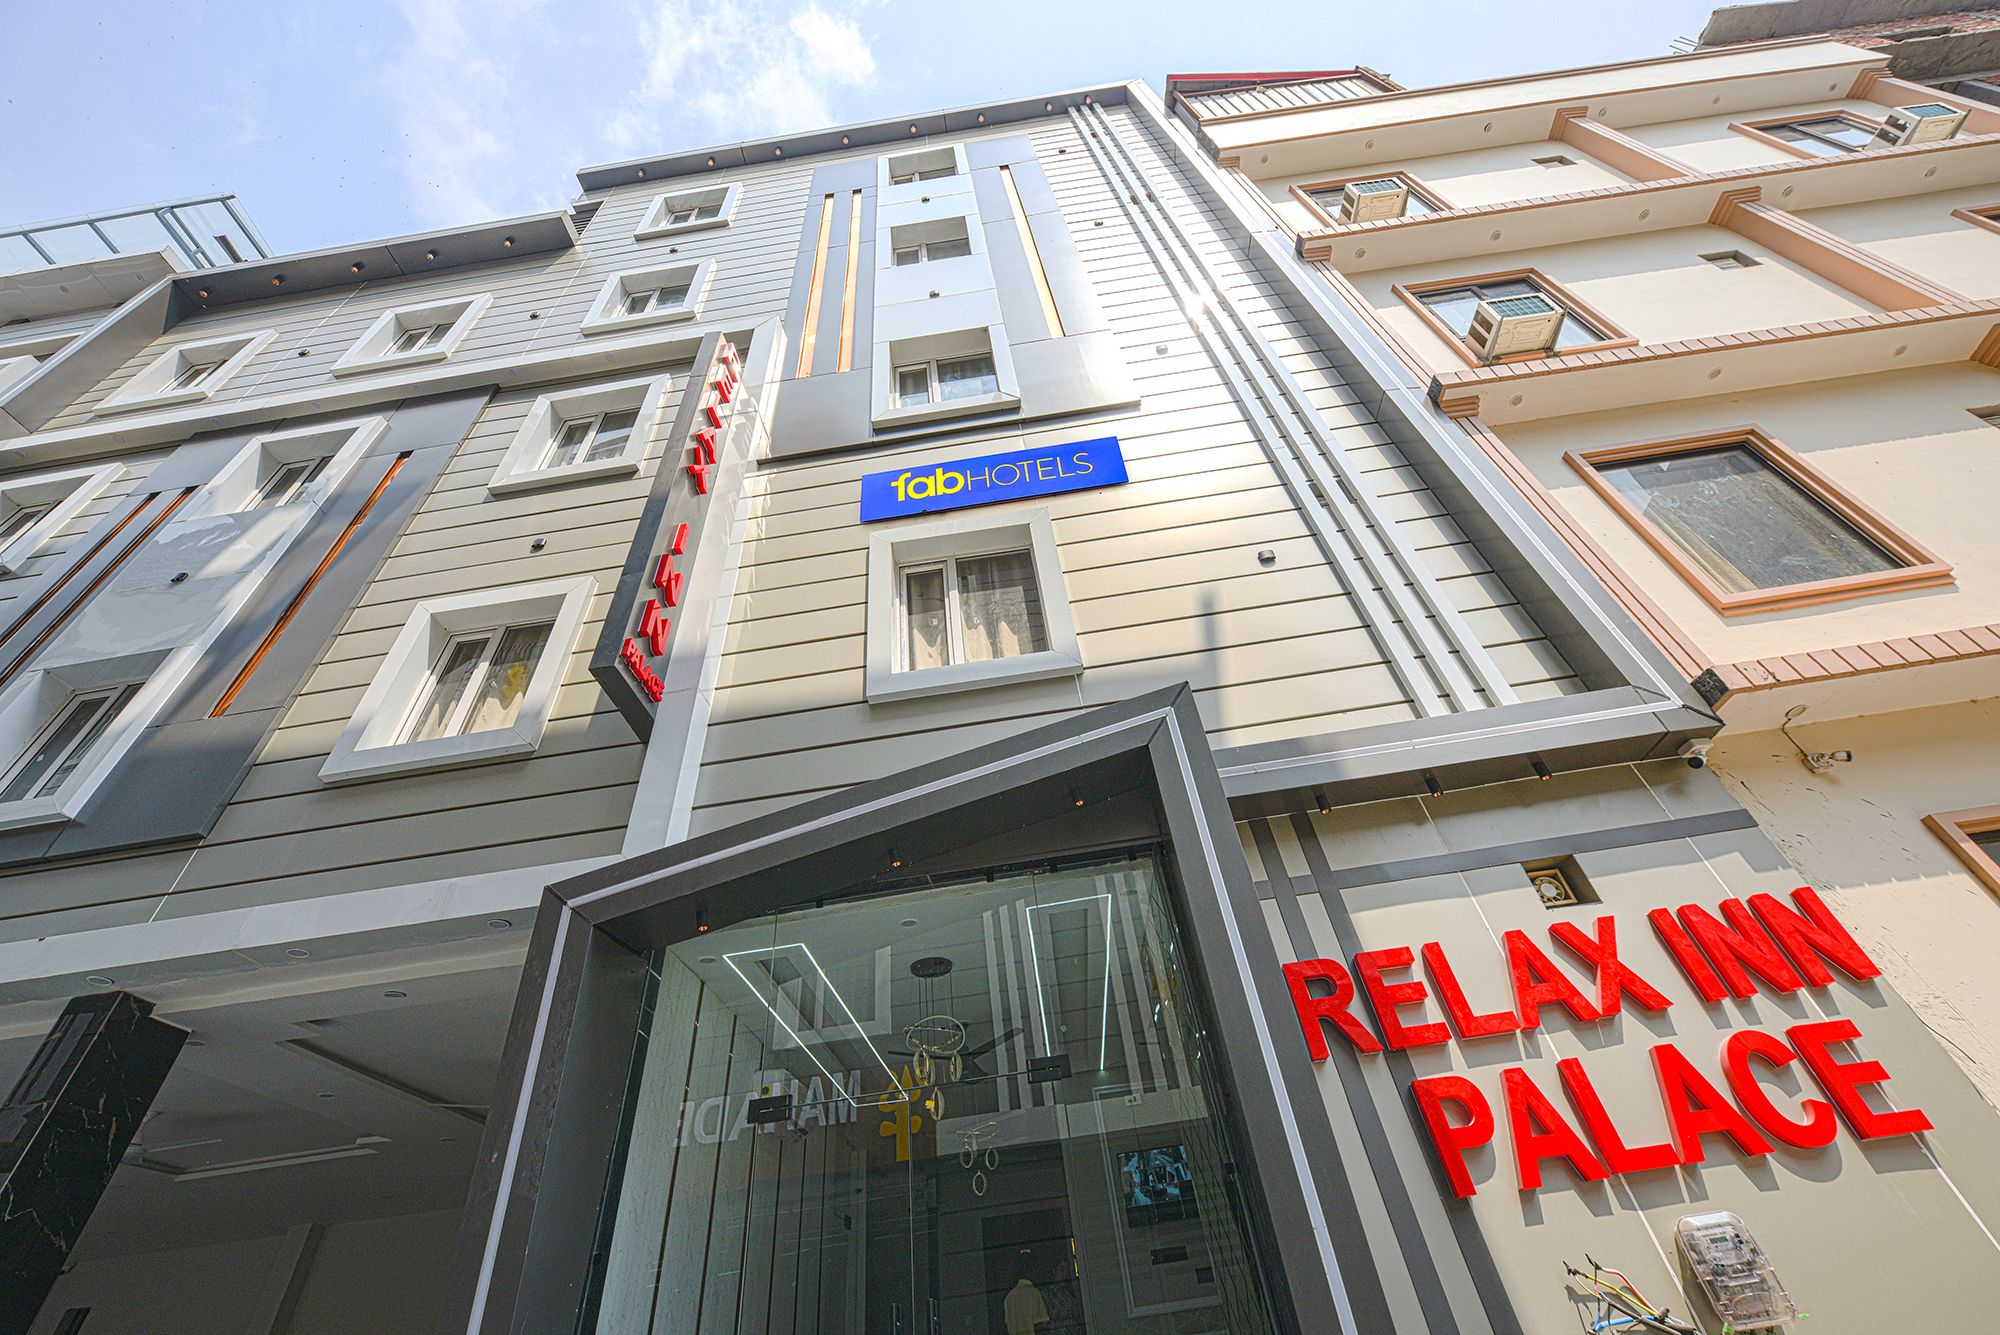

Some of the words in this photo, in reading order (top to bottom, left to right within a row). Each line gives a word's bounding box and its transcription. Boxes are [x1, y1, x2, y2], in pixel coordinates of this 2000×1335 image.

[636, 523, 691, 657] INN
[620, 637, 666, 703] PALACE
[1281, 915, 1674, 1062] RELAX
[1647, 886, 1883, 1004] INN
[1410, 1018, 1935, 1199] PALACE
